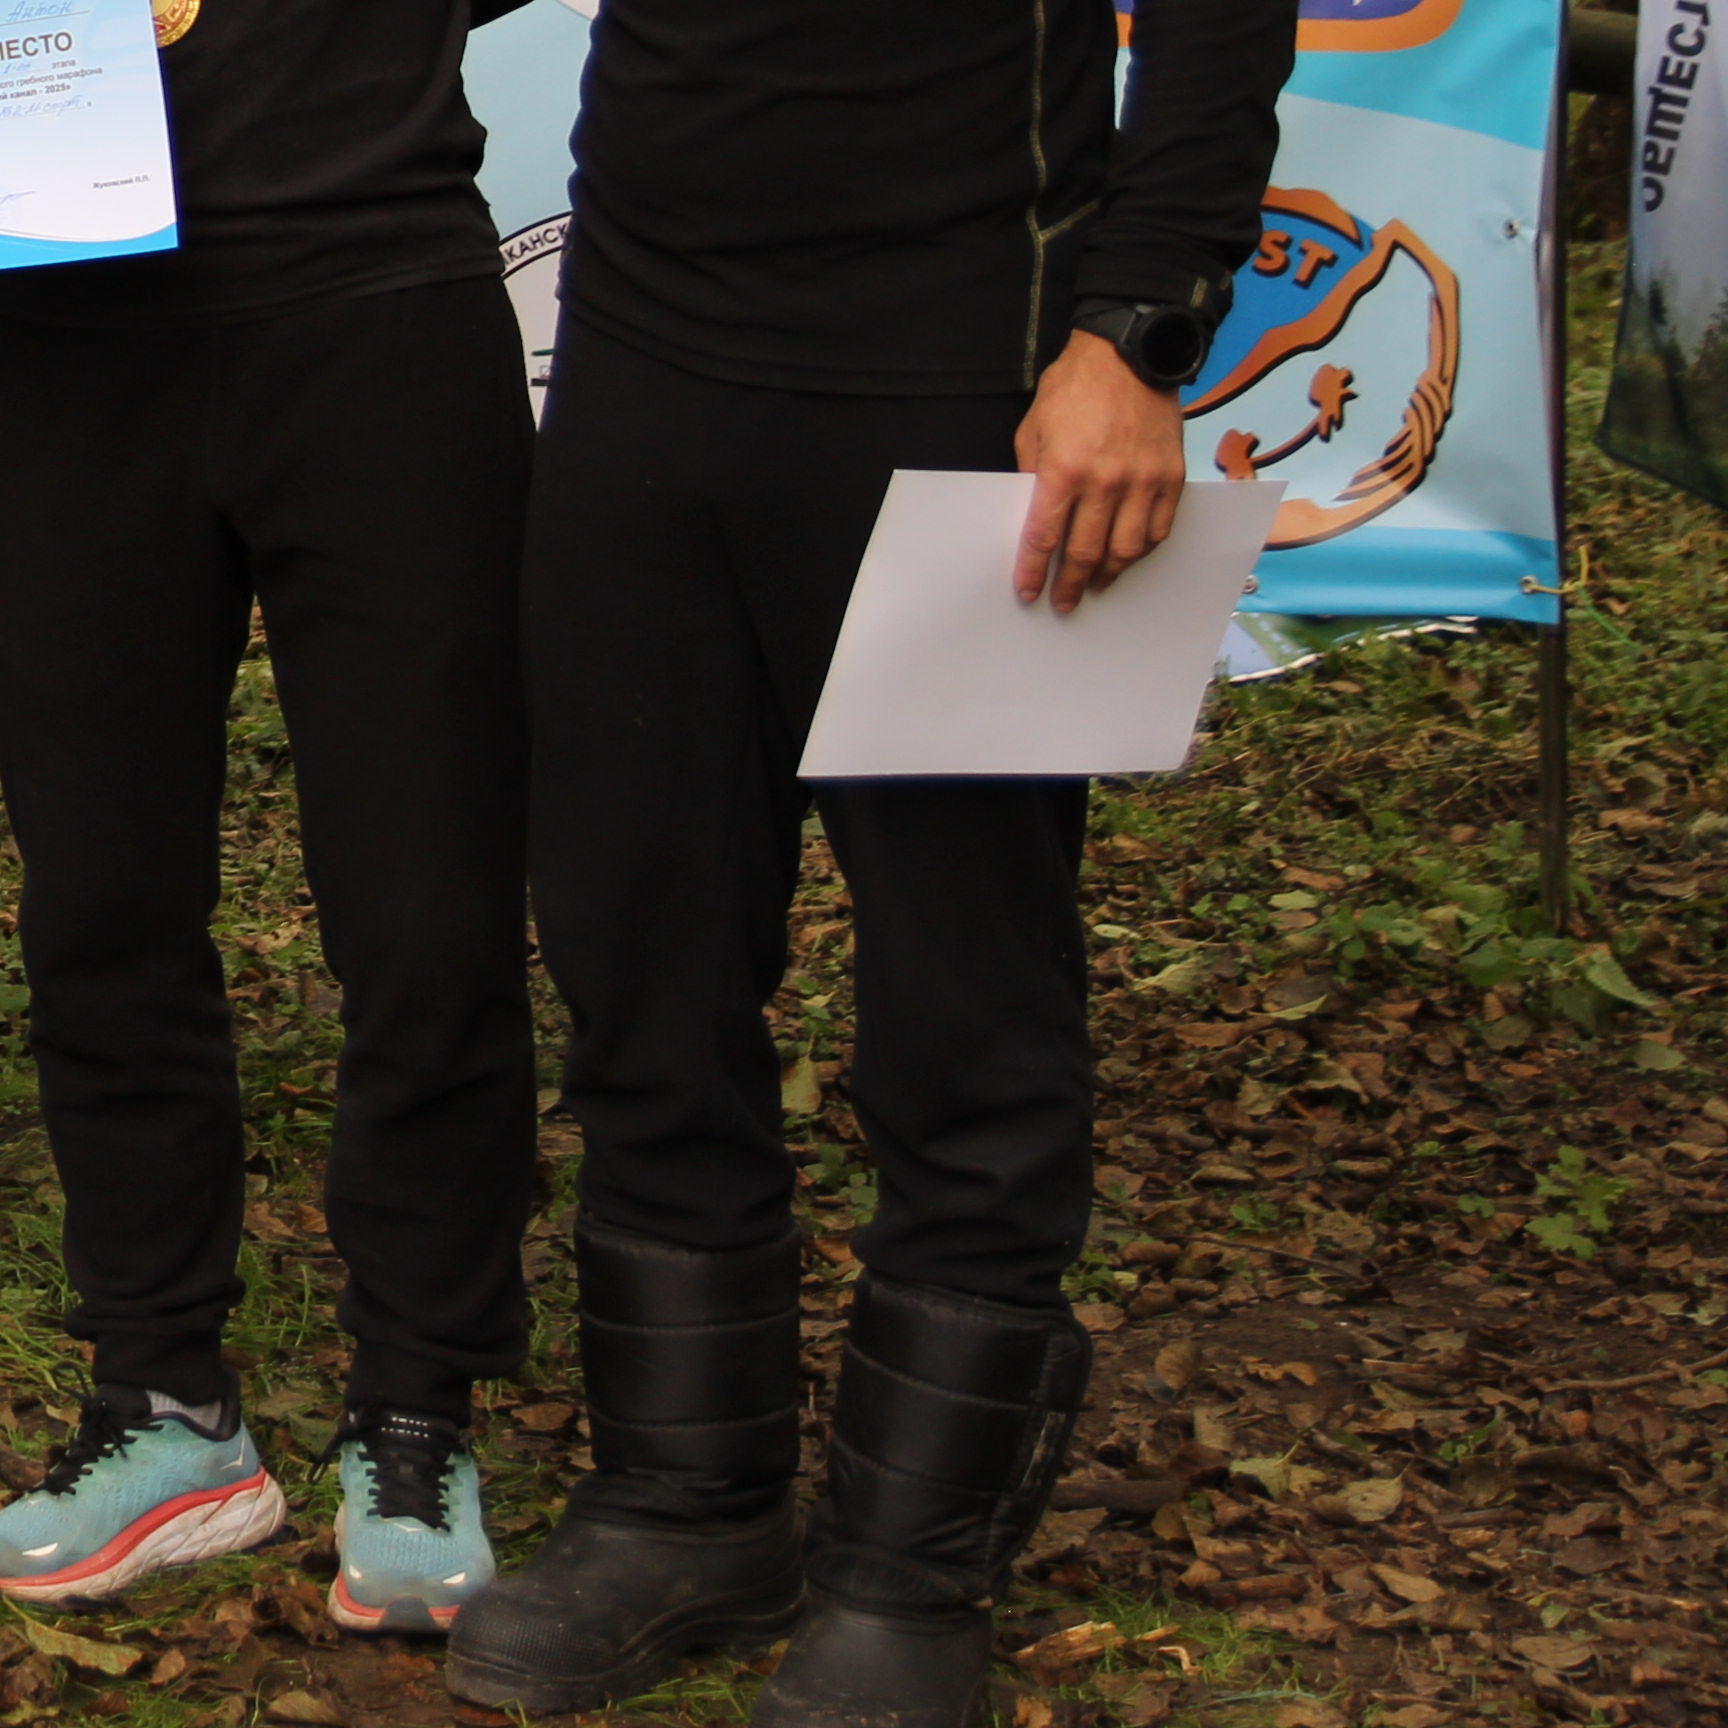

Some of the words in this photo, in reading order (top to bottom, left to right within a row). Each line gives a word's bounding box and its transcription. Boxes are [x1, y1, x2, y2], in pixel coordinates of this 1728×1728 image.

[51, 58, 76, 69] этапа
[16, 73, 54, 87] гребного
[56, 65, 103, 81] марафона
[9, 87, 37, 100] канал
[1252, 228, 1339, 290] ST
